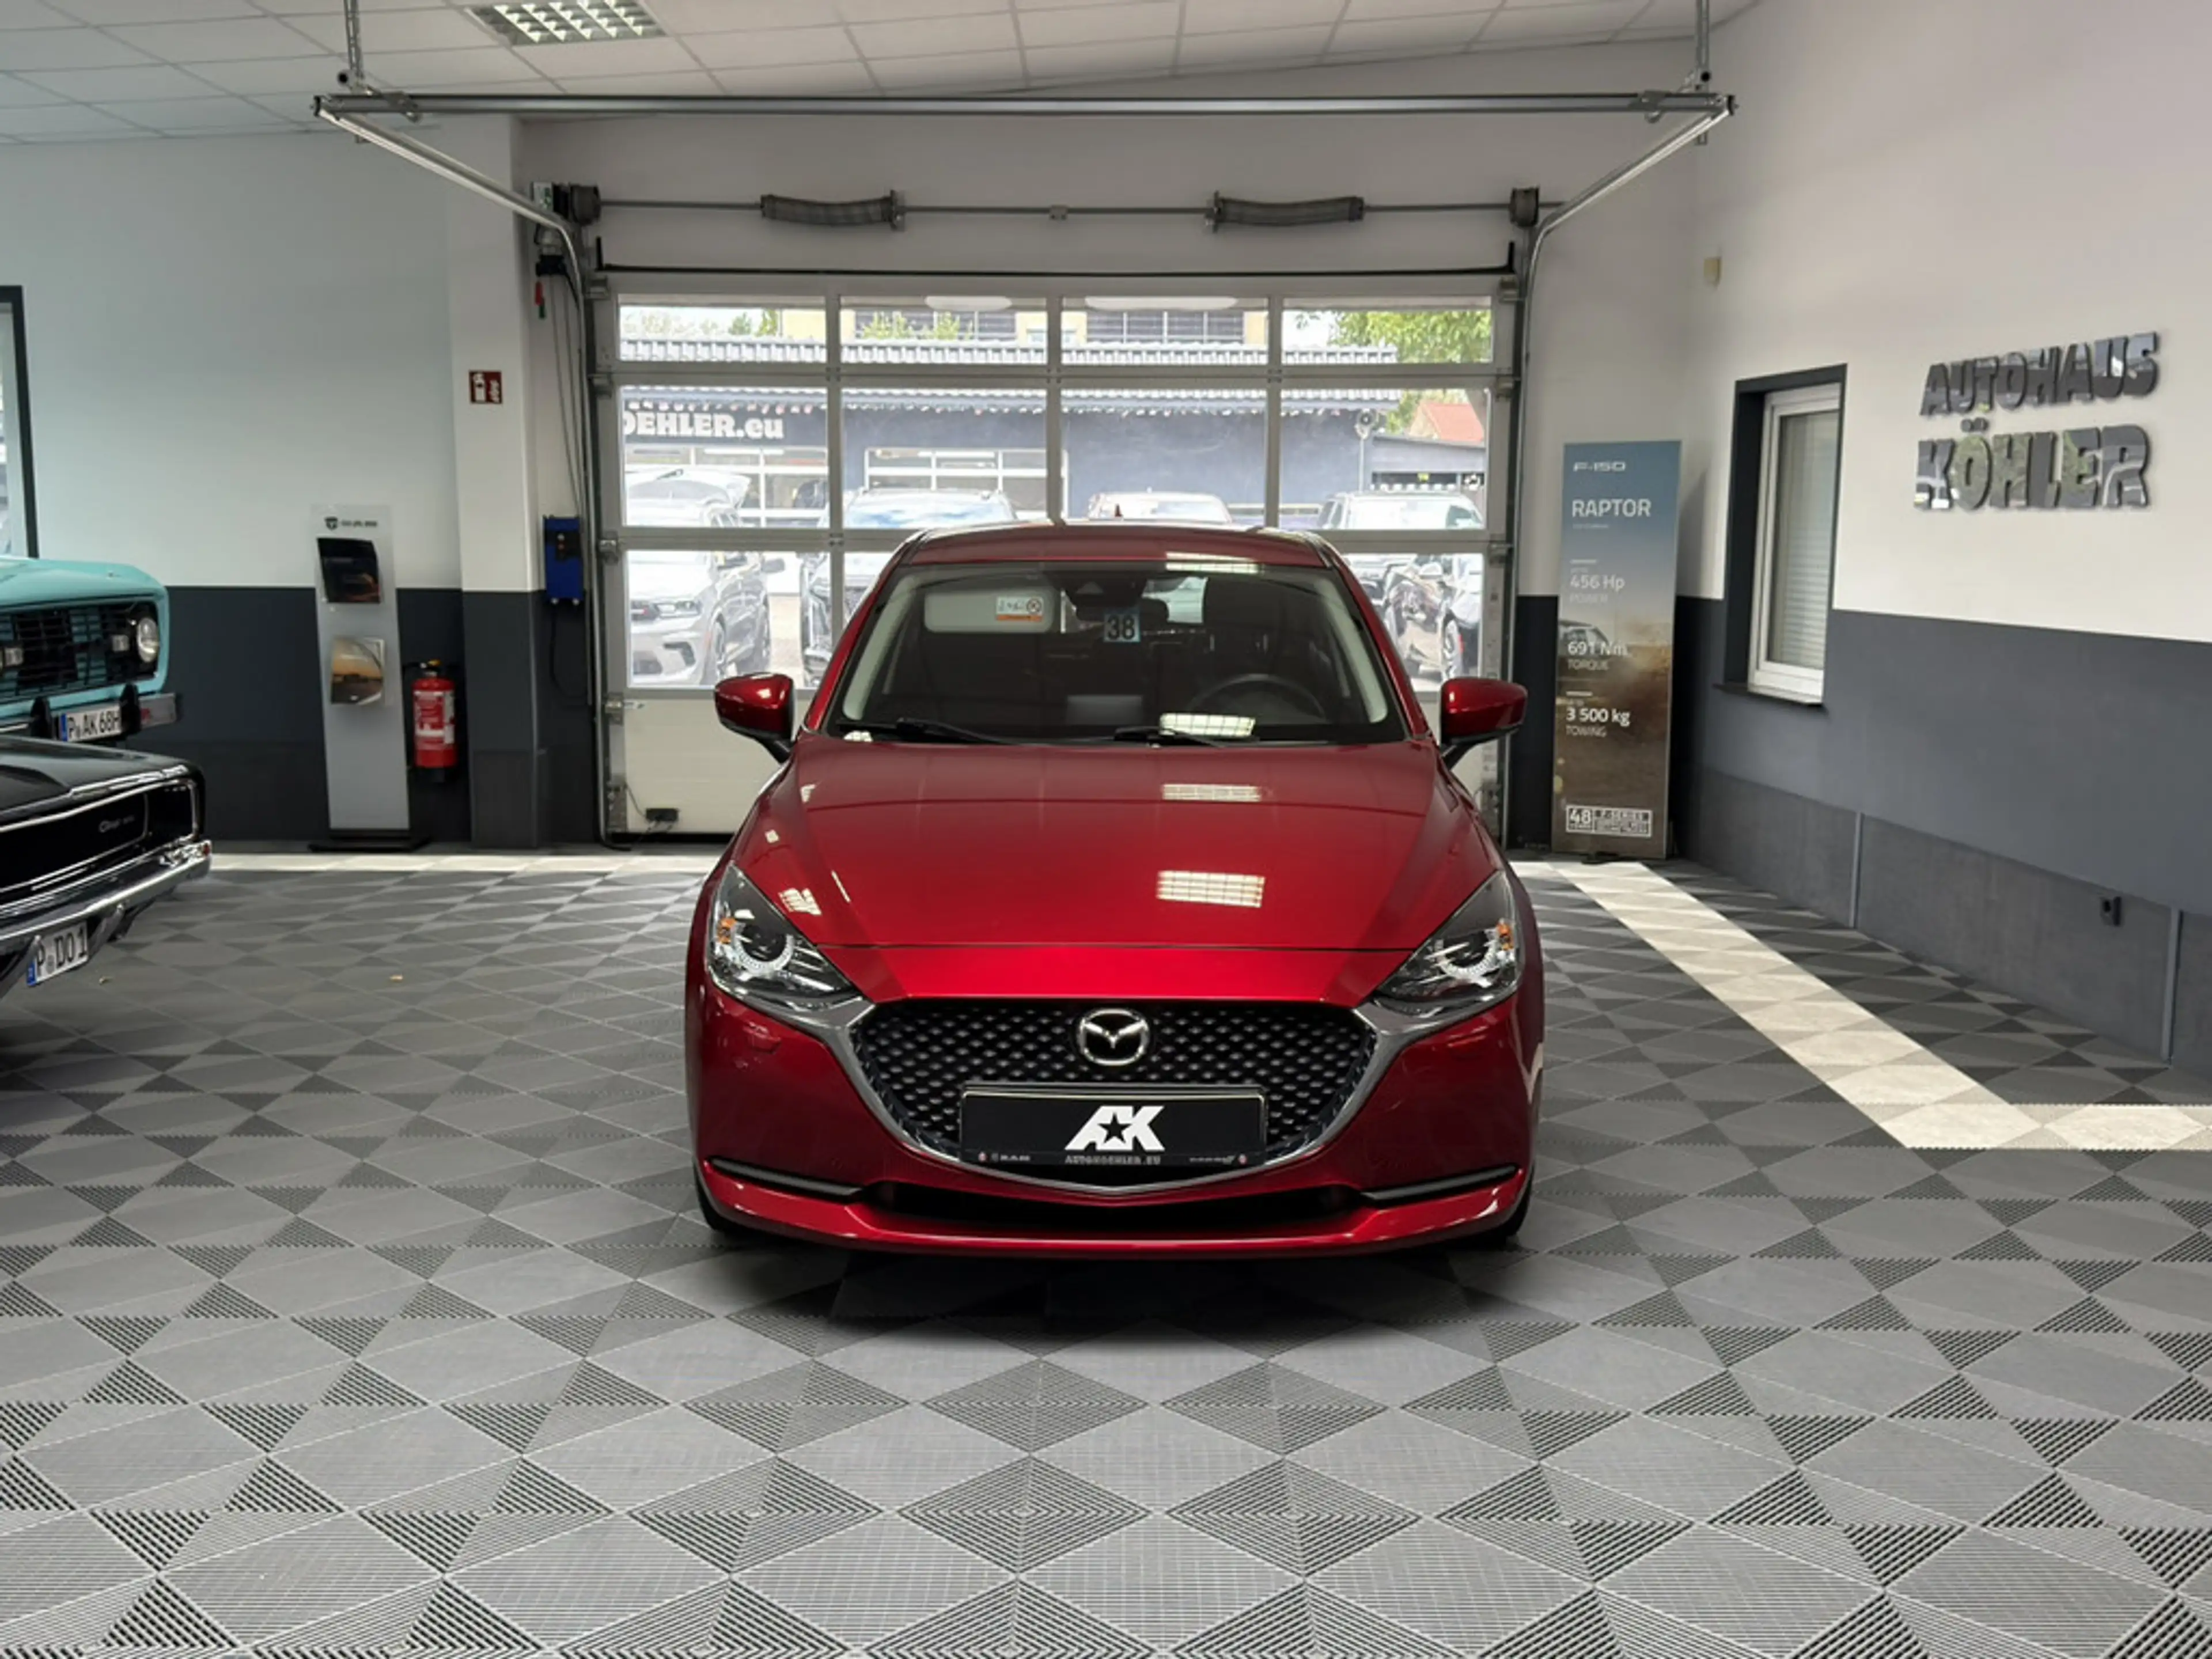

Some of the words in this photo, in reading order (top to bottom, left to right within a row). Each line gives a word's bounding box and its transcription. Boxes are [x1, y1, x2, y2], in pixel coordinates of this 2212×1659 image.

[1919, 332, 2158, 416] AUTOHAUS
[1914, 417, 2150, 510] KÖHLER
[1572, 499, 1652, 517] RAPTOR
[1570, 575, 1600, 589] 456
[1603, 574, 1625, 593] Hp
[1108, 615, 1134, 639] 38
[1568, 641, 1595, 656] 691
[1566, 706, 1575, 721] 3
[1579, 707, 1609, 722] 500
[1611, 708, 1631, 727] kg
